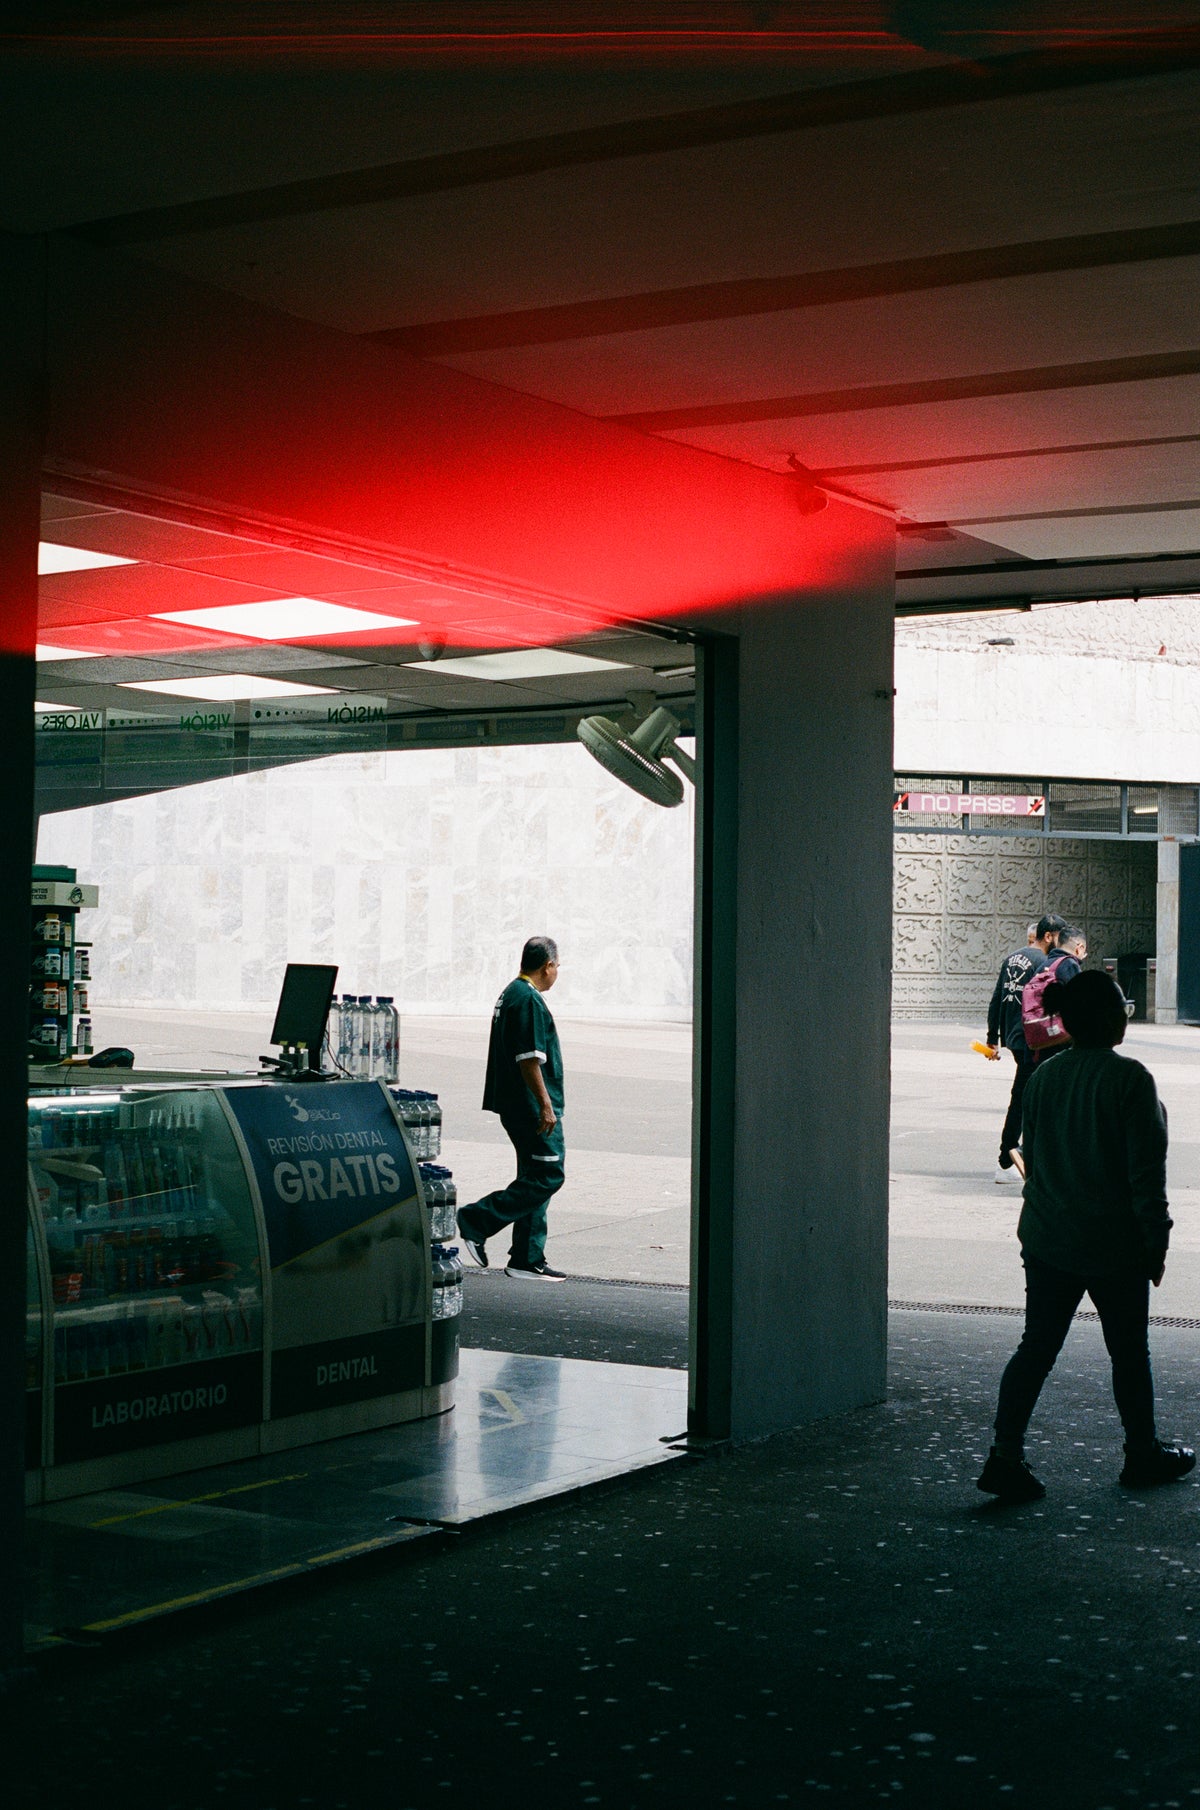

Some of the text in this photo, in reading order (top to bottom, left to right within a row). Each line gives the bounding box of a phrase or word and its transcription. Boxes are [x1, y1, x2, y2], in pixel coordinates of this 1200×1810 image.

[920, 795, 1016, 813] NO PASE
[267, 1130, 388, 1155] REVISIÓN DENTAL
[273, 1152, 400, 1204] GRATIS
[316, 1355, 378, 1387] DENTAL
[91, 1383, 227, 1429] LABORATORIO
